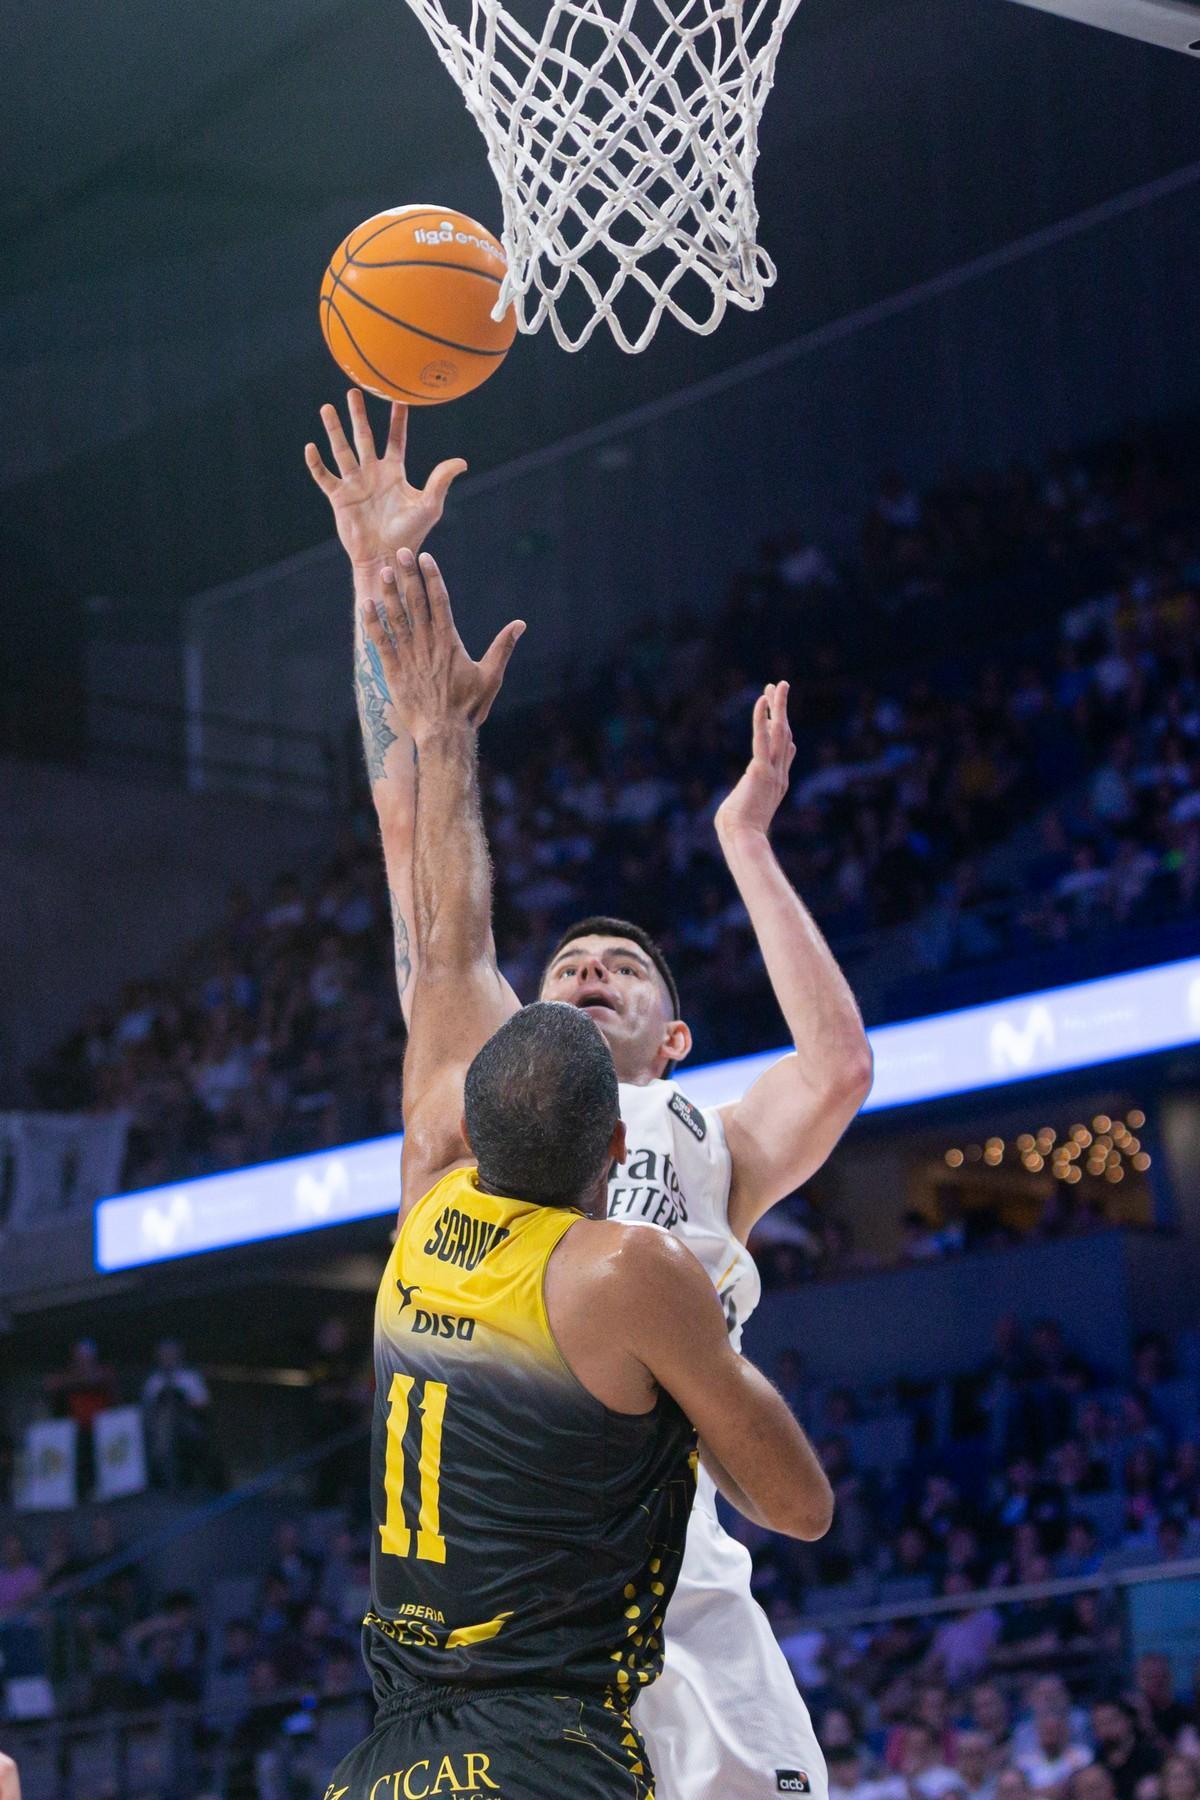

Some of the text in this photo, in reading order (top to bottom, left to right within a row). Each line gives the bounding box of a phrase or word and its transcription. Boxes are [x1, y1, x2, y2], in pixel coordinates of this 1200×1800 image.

[414, 228, 454, 245] liga
[608, 1187, 679, 1230] ETTER
[379, 1372, 448, 1564] 11
[399, 1603, 446, 1624] IBERIA
[369, 1752, 500, 1800] CICAR
[780, 1778, 804, 1791] acb
